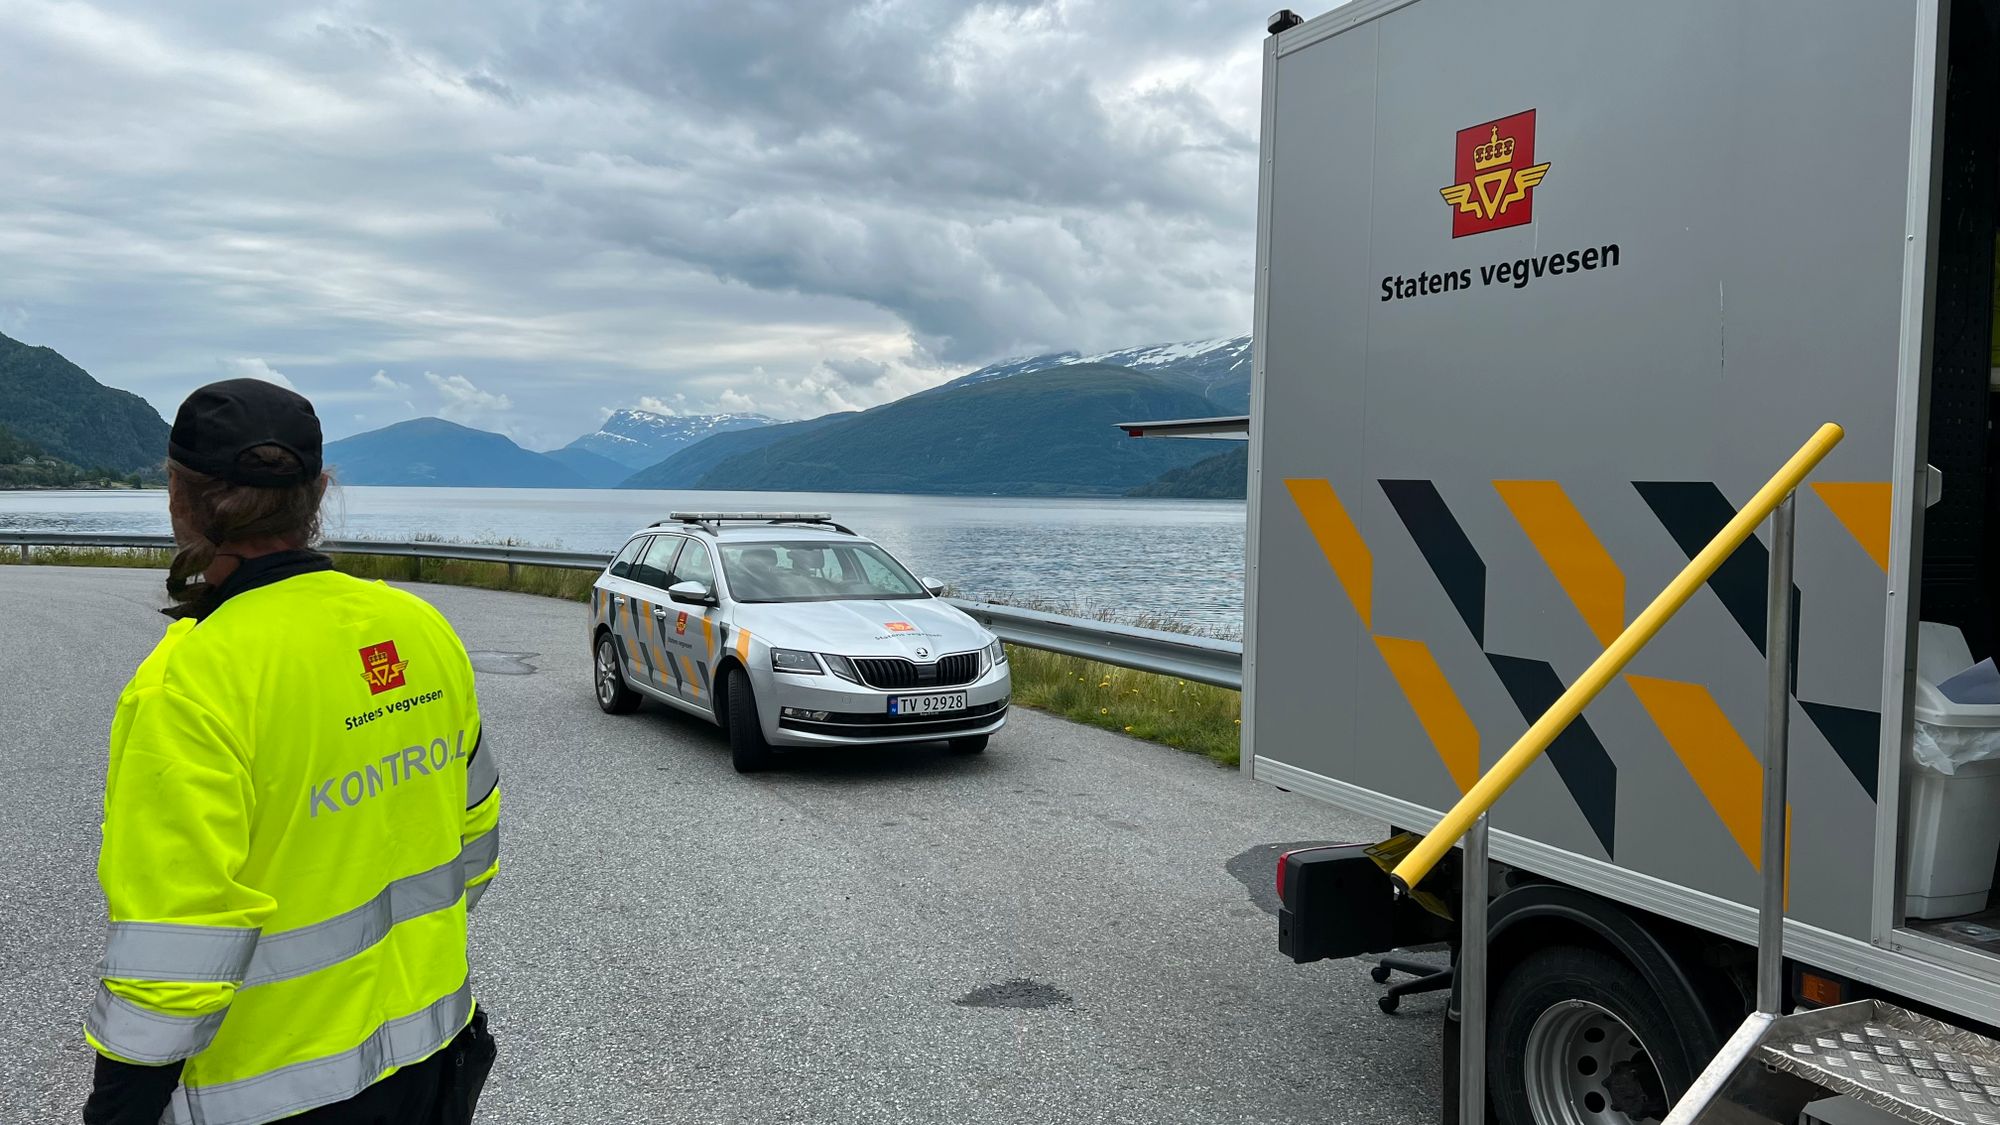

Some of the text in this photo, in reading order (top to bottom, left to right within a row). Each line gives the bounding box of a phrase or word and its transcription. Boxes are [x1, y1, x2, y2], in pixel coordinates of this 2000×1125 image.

[1381, 243, 1620, 302] Statens vegvesen
[386, 689, 443, 713] vegvesen
[901, 695, 963, 712] TV 92928
